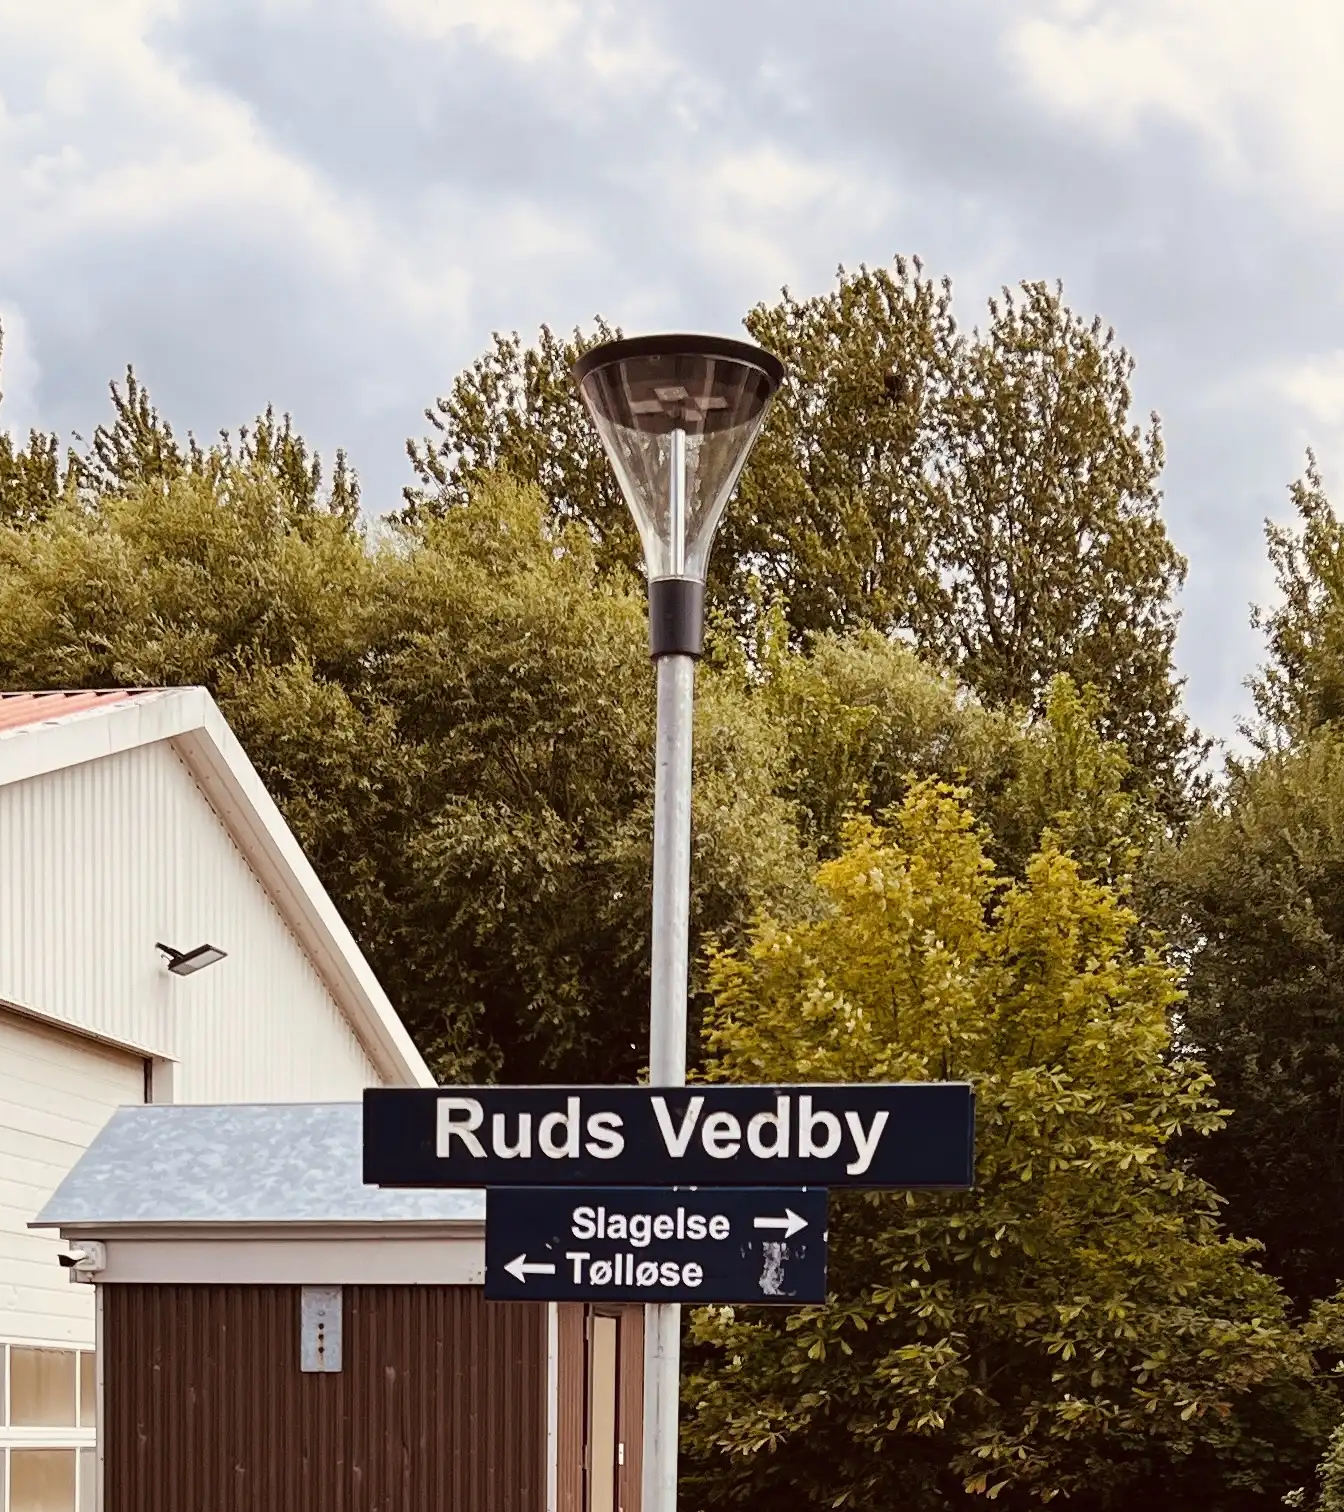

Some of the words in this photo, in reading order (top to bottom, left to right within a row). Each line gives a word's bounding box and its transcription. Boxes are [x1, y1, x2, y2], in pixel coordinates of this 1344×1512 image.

[436, 1096, 625, 1159] Ruds
[650, 1095, 890, 1176] Vedby
[571, 1206, 731, 1248] Slagelse
[565, 1251, 704, 1288] Tølløse
